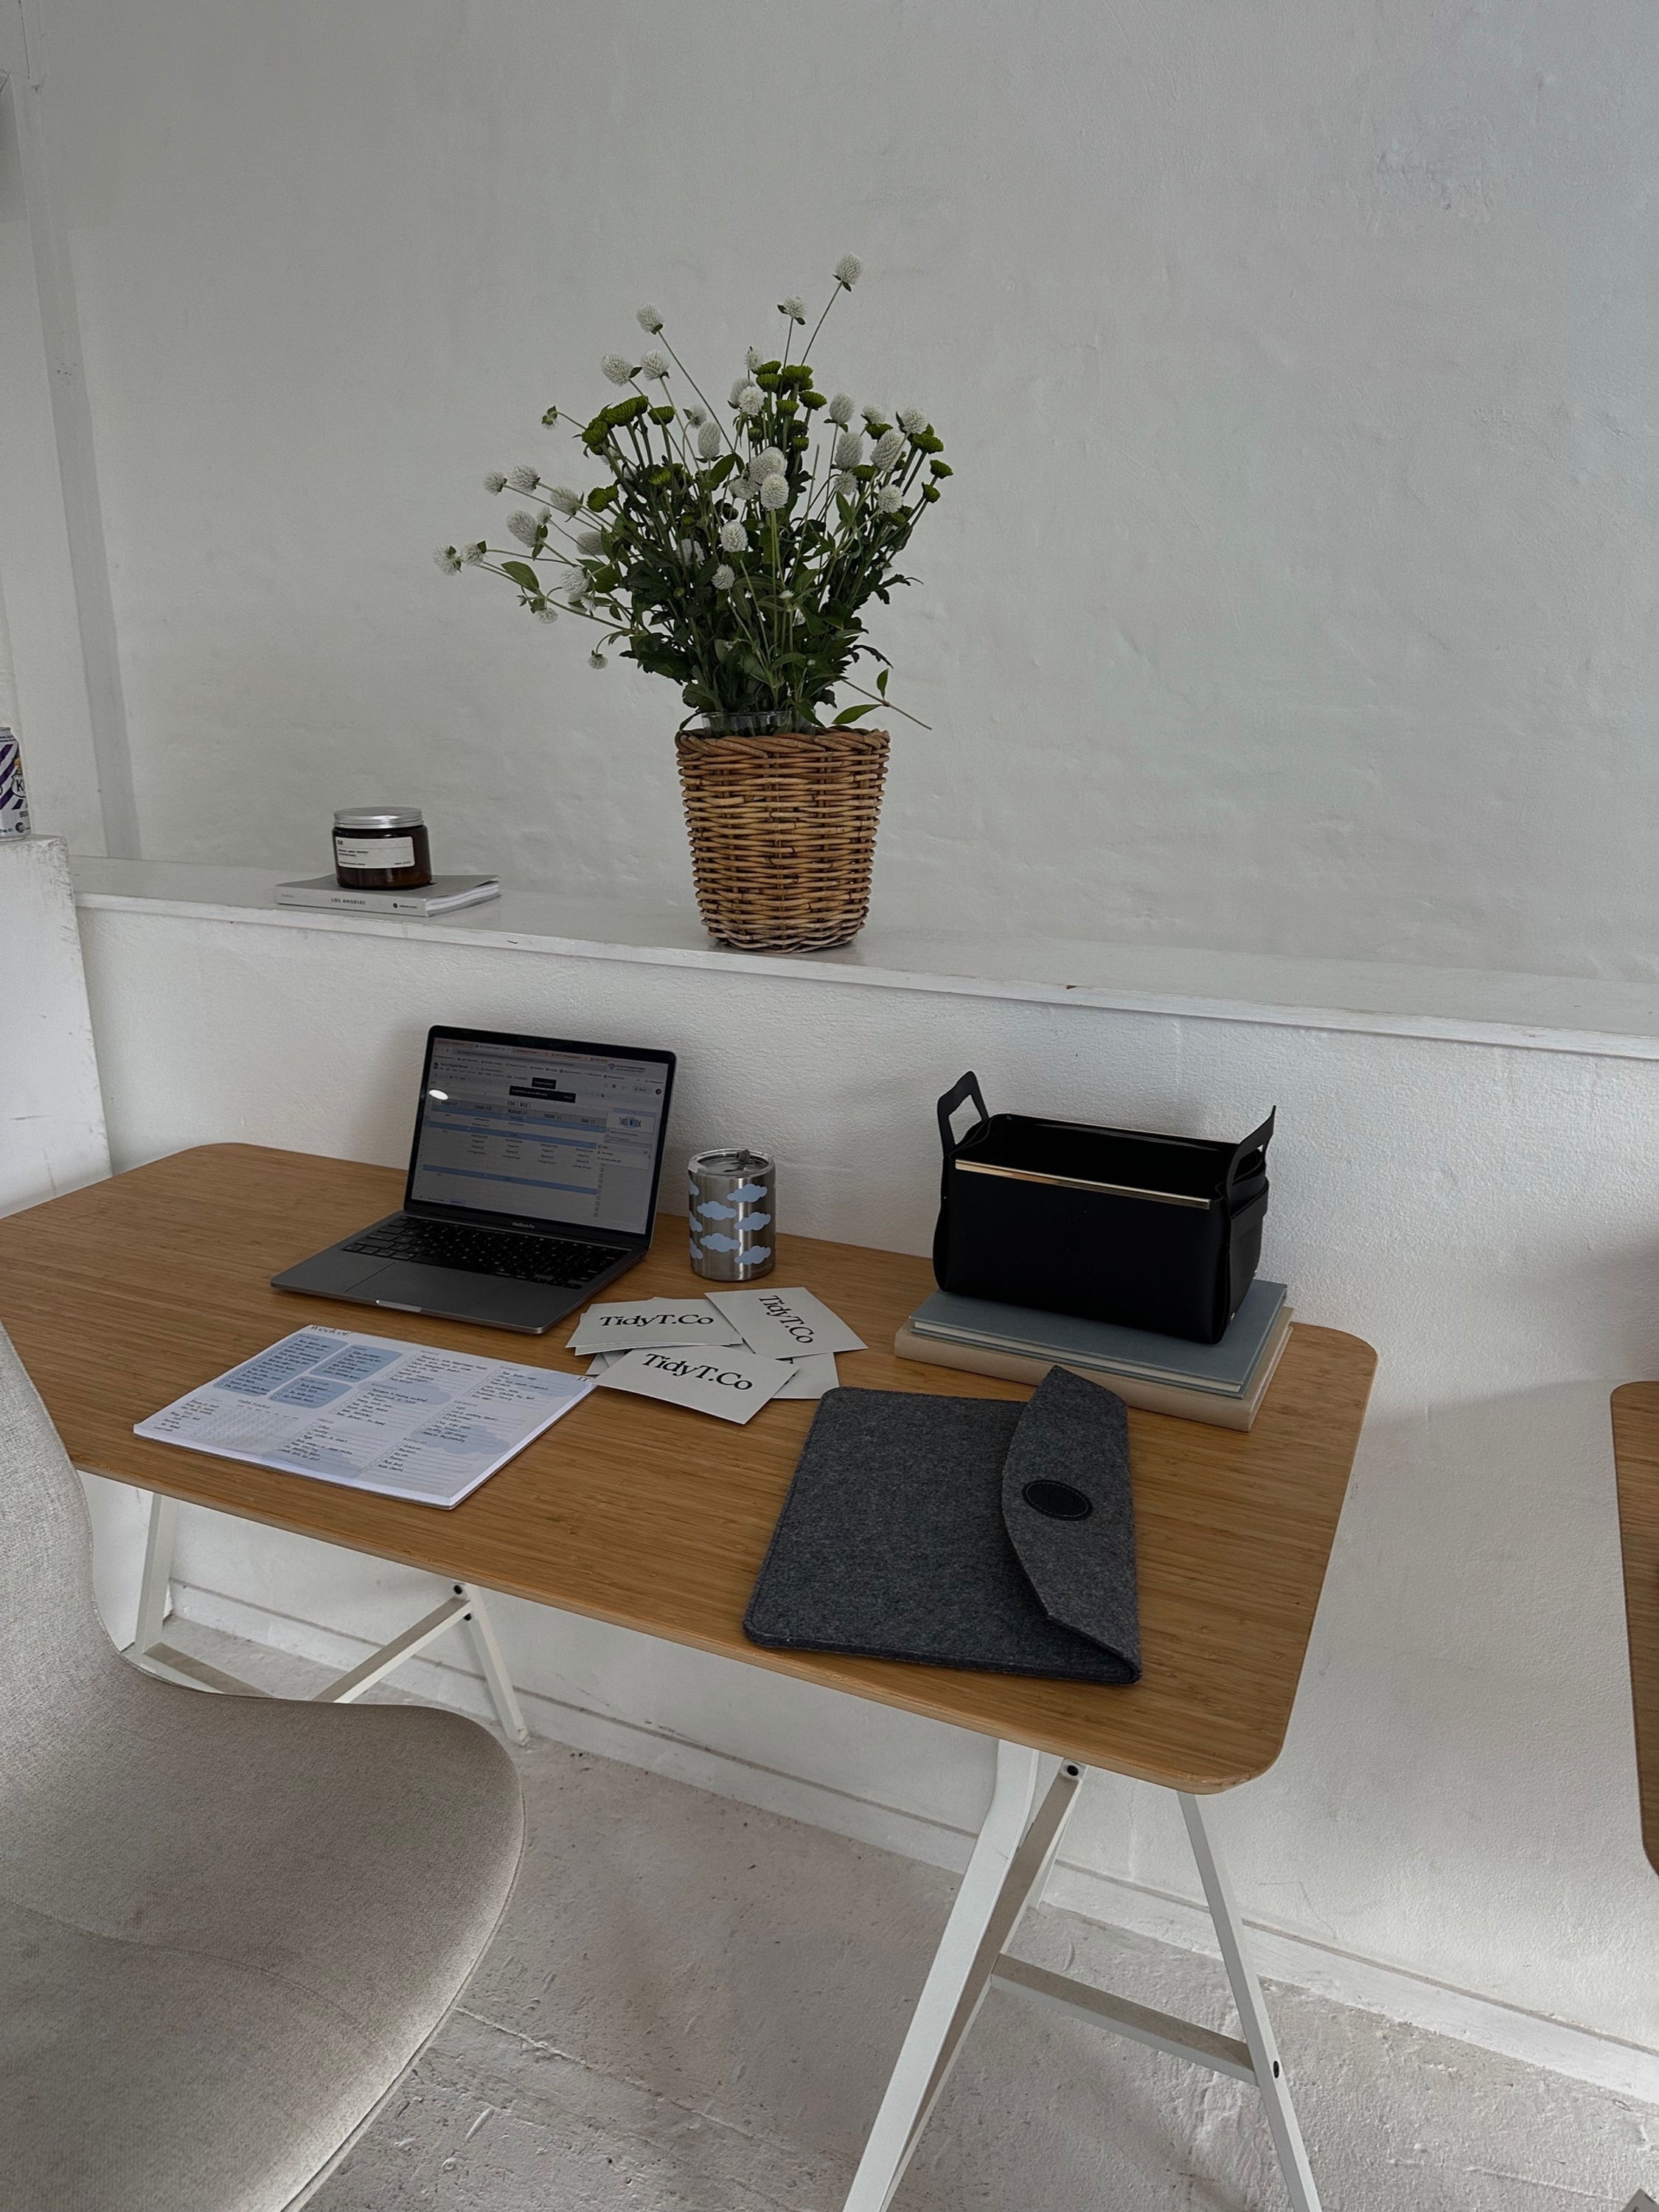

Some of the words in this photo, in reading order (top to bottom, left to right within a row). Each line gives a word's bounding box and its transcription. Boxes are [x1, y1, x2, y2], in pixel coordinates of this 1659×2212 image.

[599, 1314, 714, 1326] TidyT.Co
[759, 1295, 813, 1344] TidyT.Co
[642, 1353, 753, 1391] TidyT.Co
